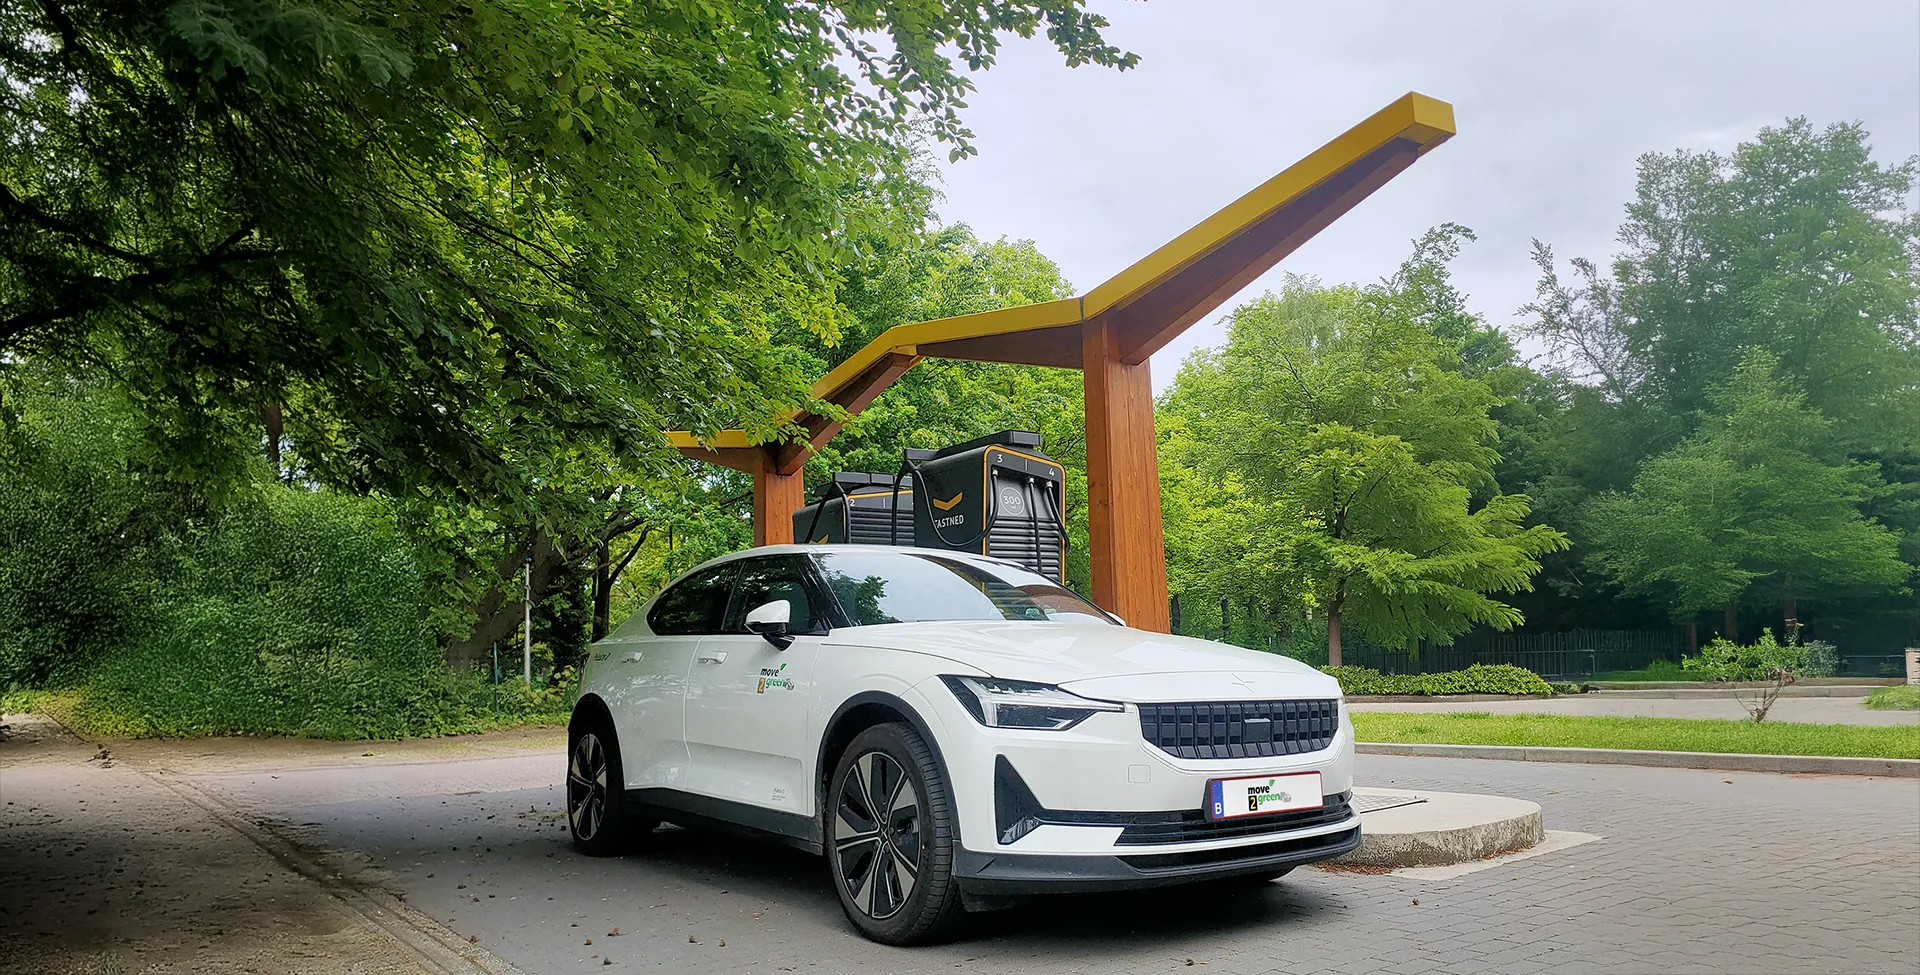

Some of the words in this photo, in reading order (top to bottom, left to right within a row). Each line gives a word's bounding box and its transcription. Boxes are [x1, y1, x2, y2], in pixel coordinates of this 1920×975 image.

[996, 453, 1003, 463] 3
[1048, 467, 1055, 476] 4
[849, 499, 856, 507] 2
[1003, 495, 1021, 505] 300
[760, 668, 780, 677] move
[757, 678, 765, 693] 2
[1248, 786, 1270, 795] move
[1249, 796, 1257, 810] 2
[1258, 792, 1281, 805] green
[1214, 802, 1223, 815] B
